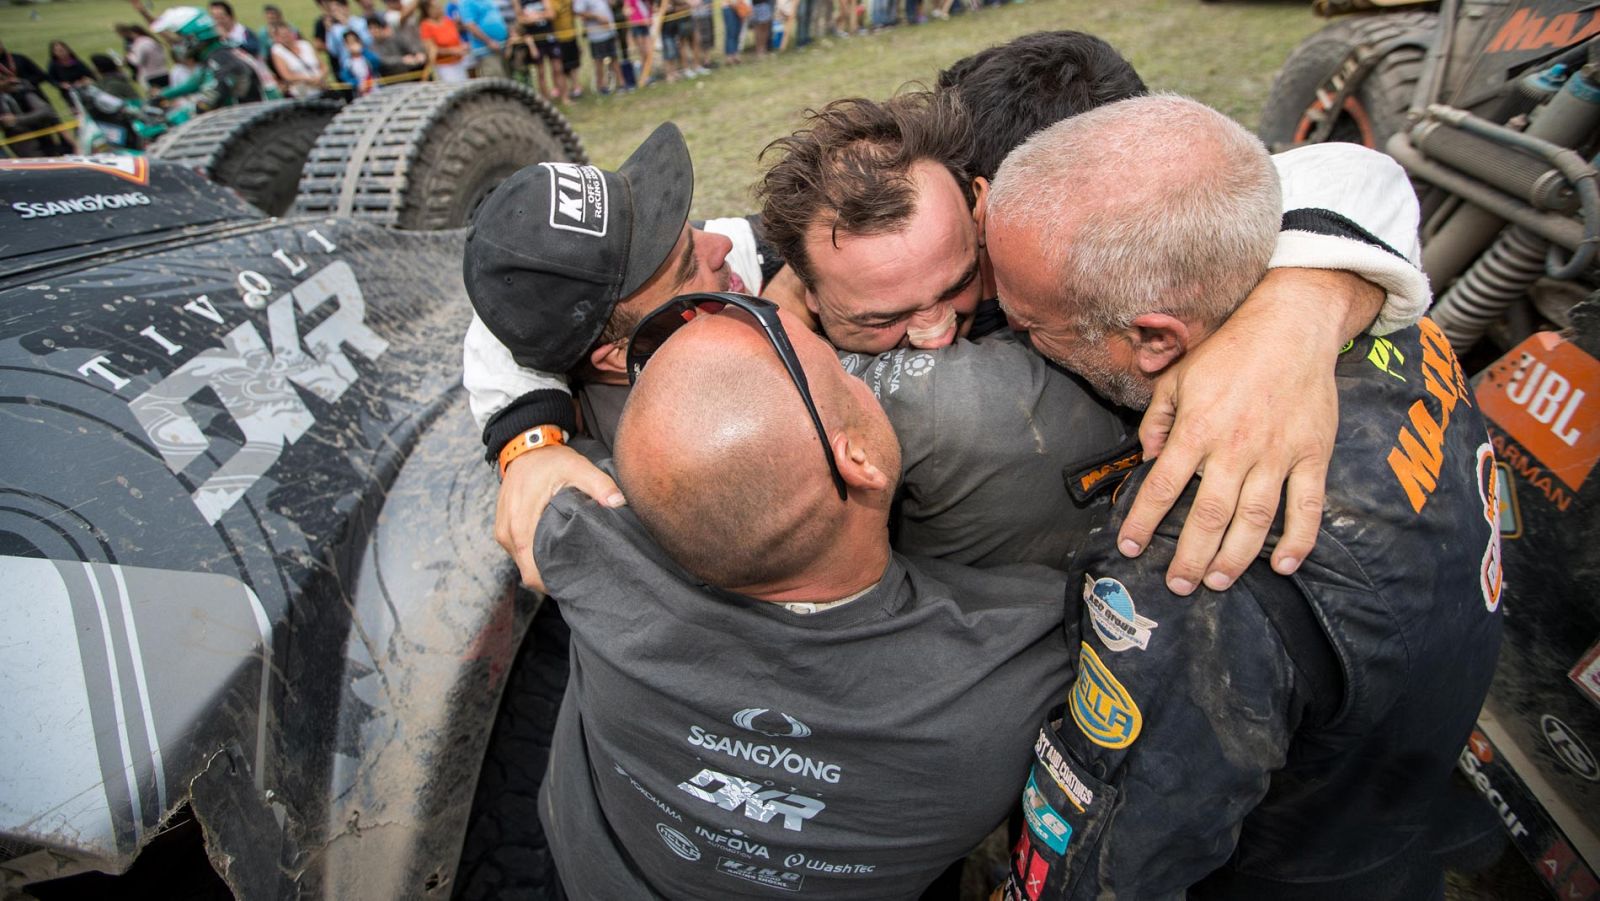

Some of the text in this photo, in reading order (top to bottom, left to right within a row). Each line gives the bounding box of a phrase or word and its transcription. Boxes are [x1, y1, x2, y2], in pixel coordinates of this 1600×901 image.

[77, 229, 337, 390] TIVOLI
[1506, 352, 1585, 447] JBL
[629, 777, 684, 823] YOKOHAMA
[1058, 761, 1094, 806] COATINGS
[695, 826, 770, 860] INFOVA
